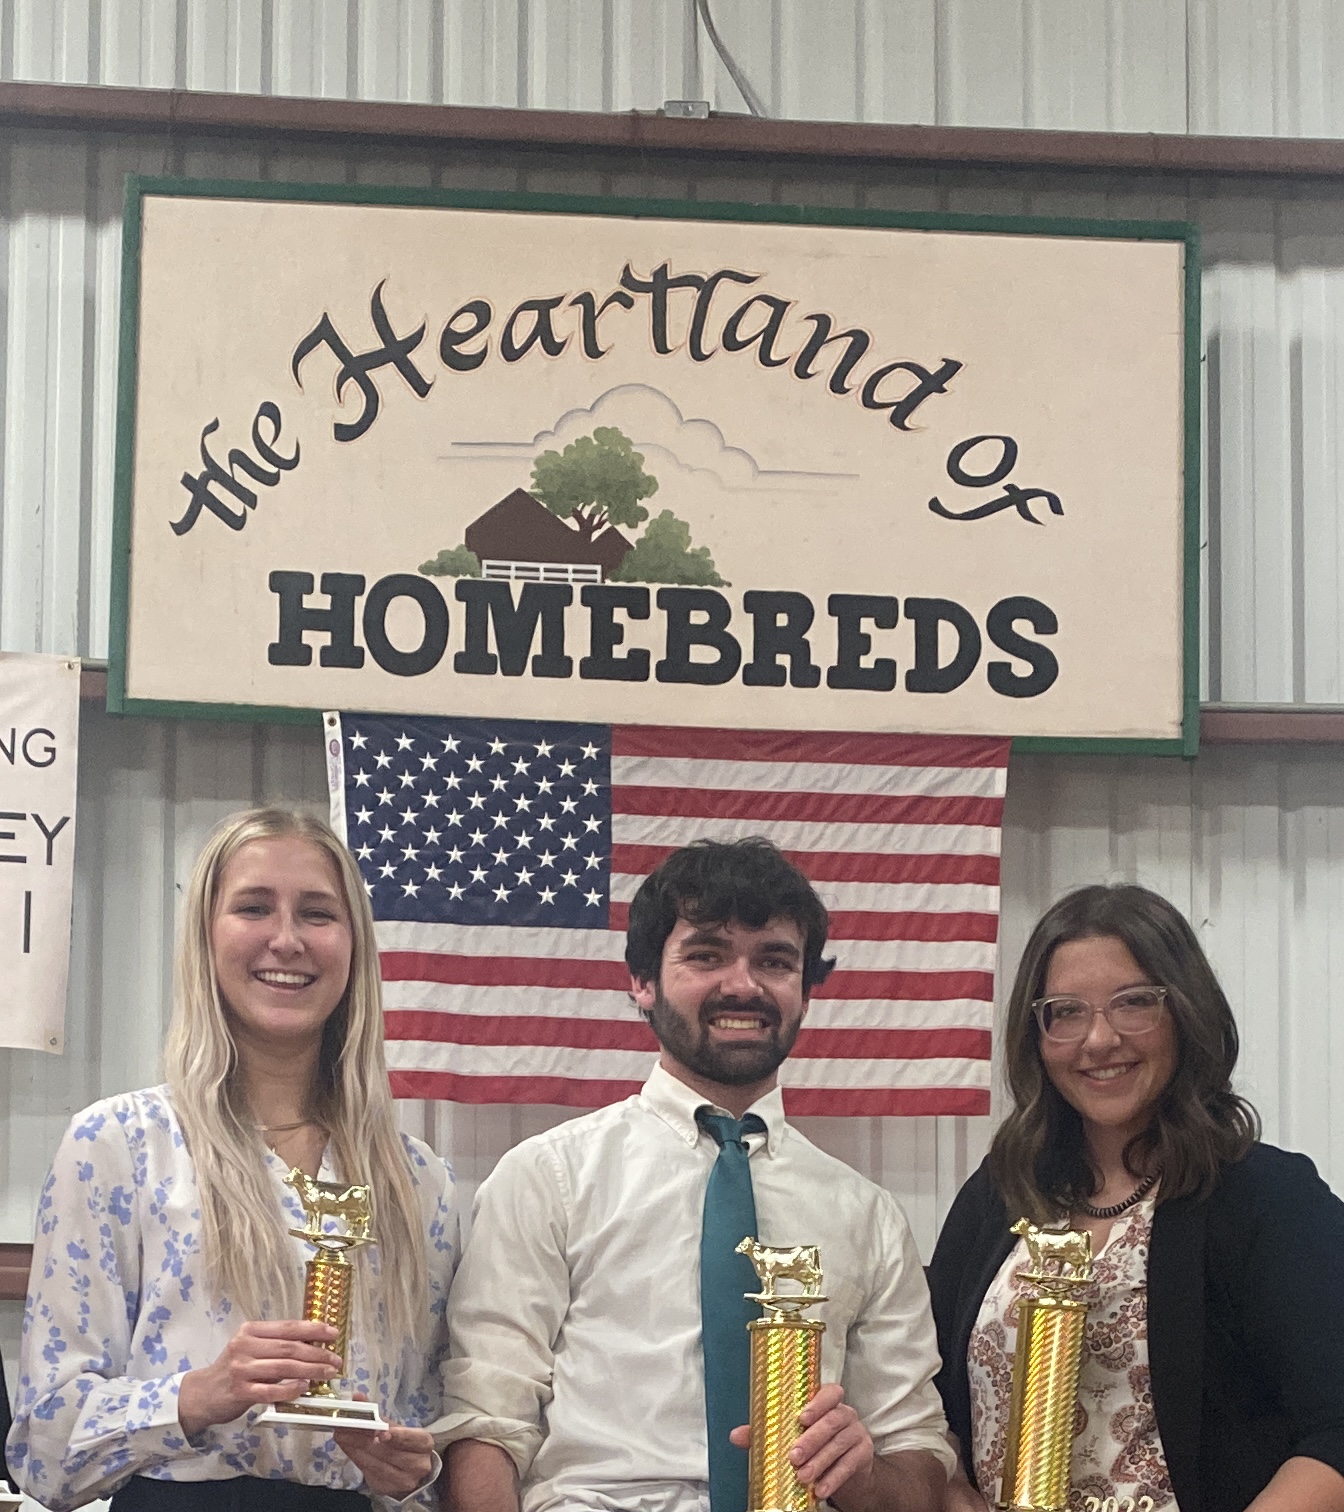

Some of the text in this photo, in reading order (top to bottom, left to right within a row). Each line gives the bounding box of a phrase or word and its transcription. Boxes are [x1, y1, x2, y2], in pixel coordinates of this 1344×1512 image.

[169, 258, 1066, 538] the Heartland of
[266, 570, 1060, 699] HOMEBREDS
